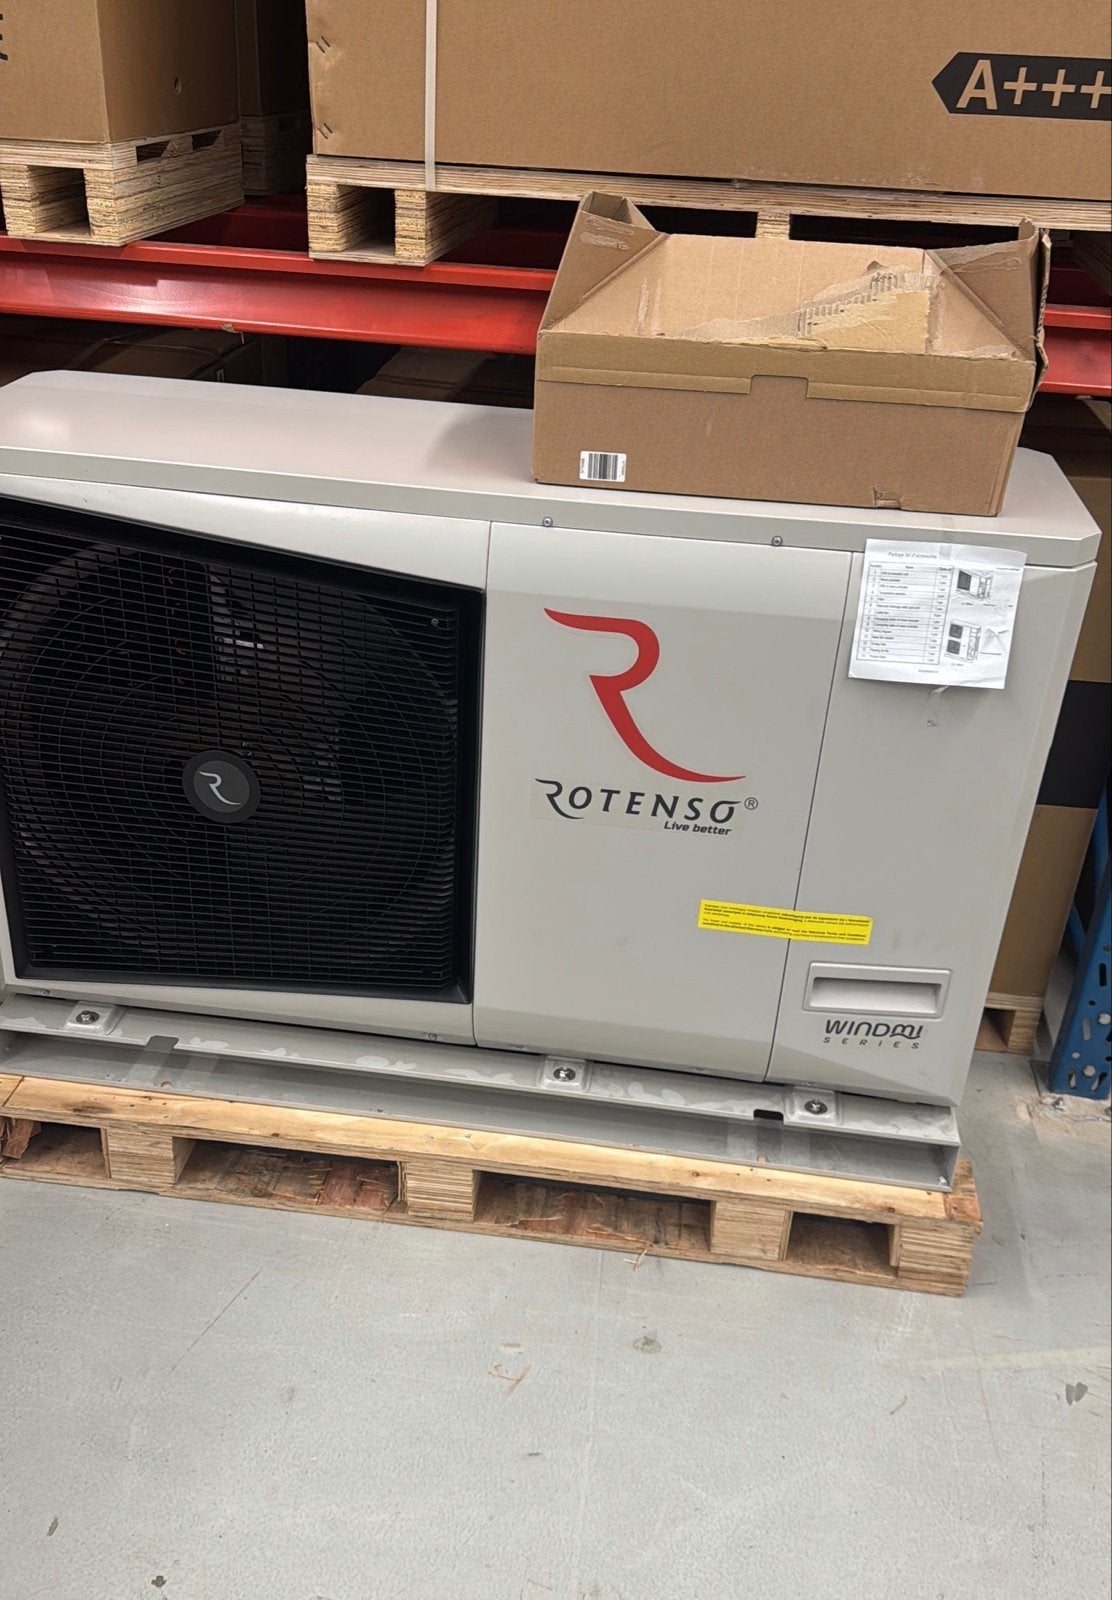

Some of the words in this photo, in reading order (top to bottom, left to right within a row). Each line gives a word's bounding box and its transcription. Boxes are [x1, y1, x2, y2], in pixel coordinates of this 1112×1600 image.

[956, 59, 1111, 110] A+++
[664, 821, 690, 831] Live
[692, 824, 732, 835] better
[823, 1036, 919, 1050] SERIES
